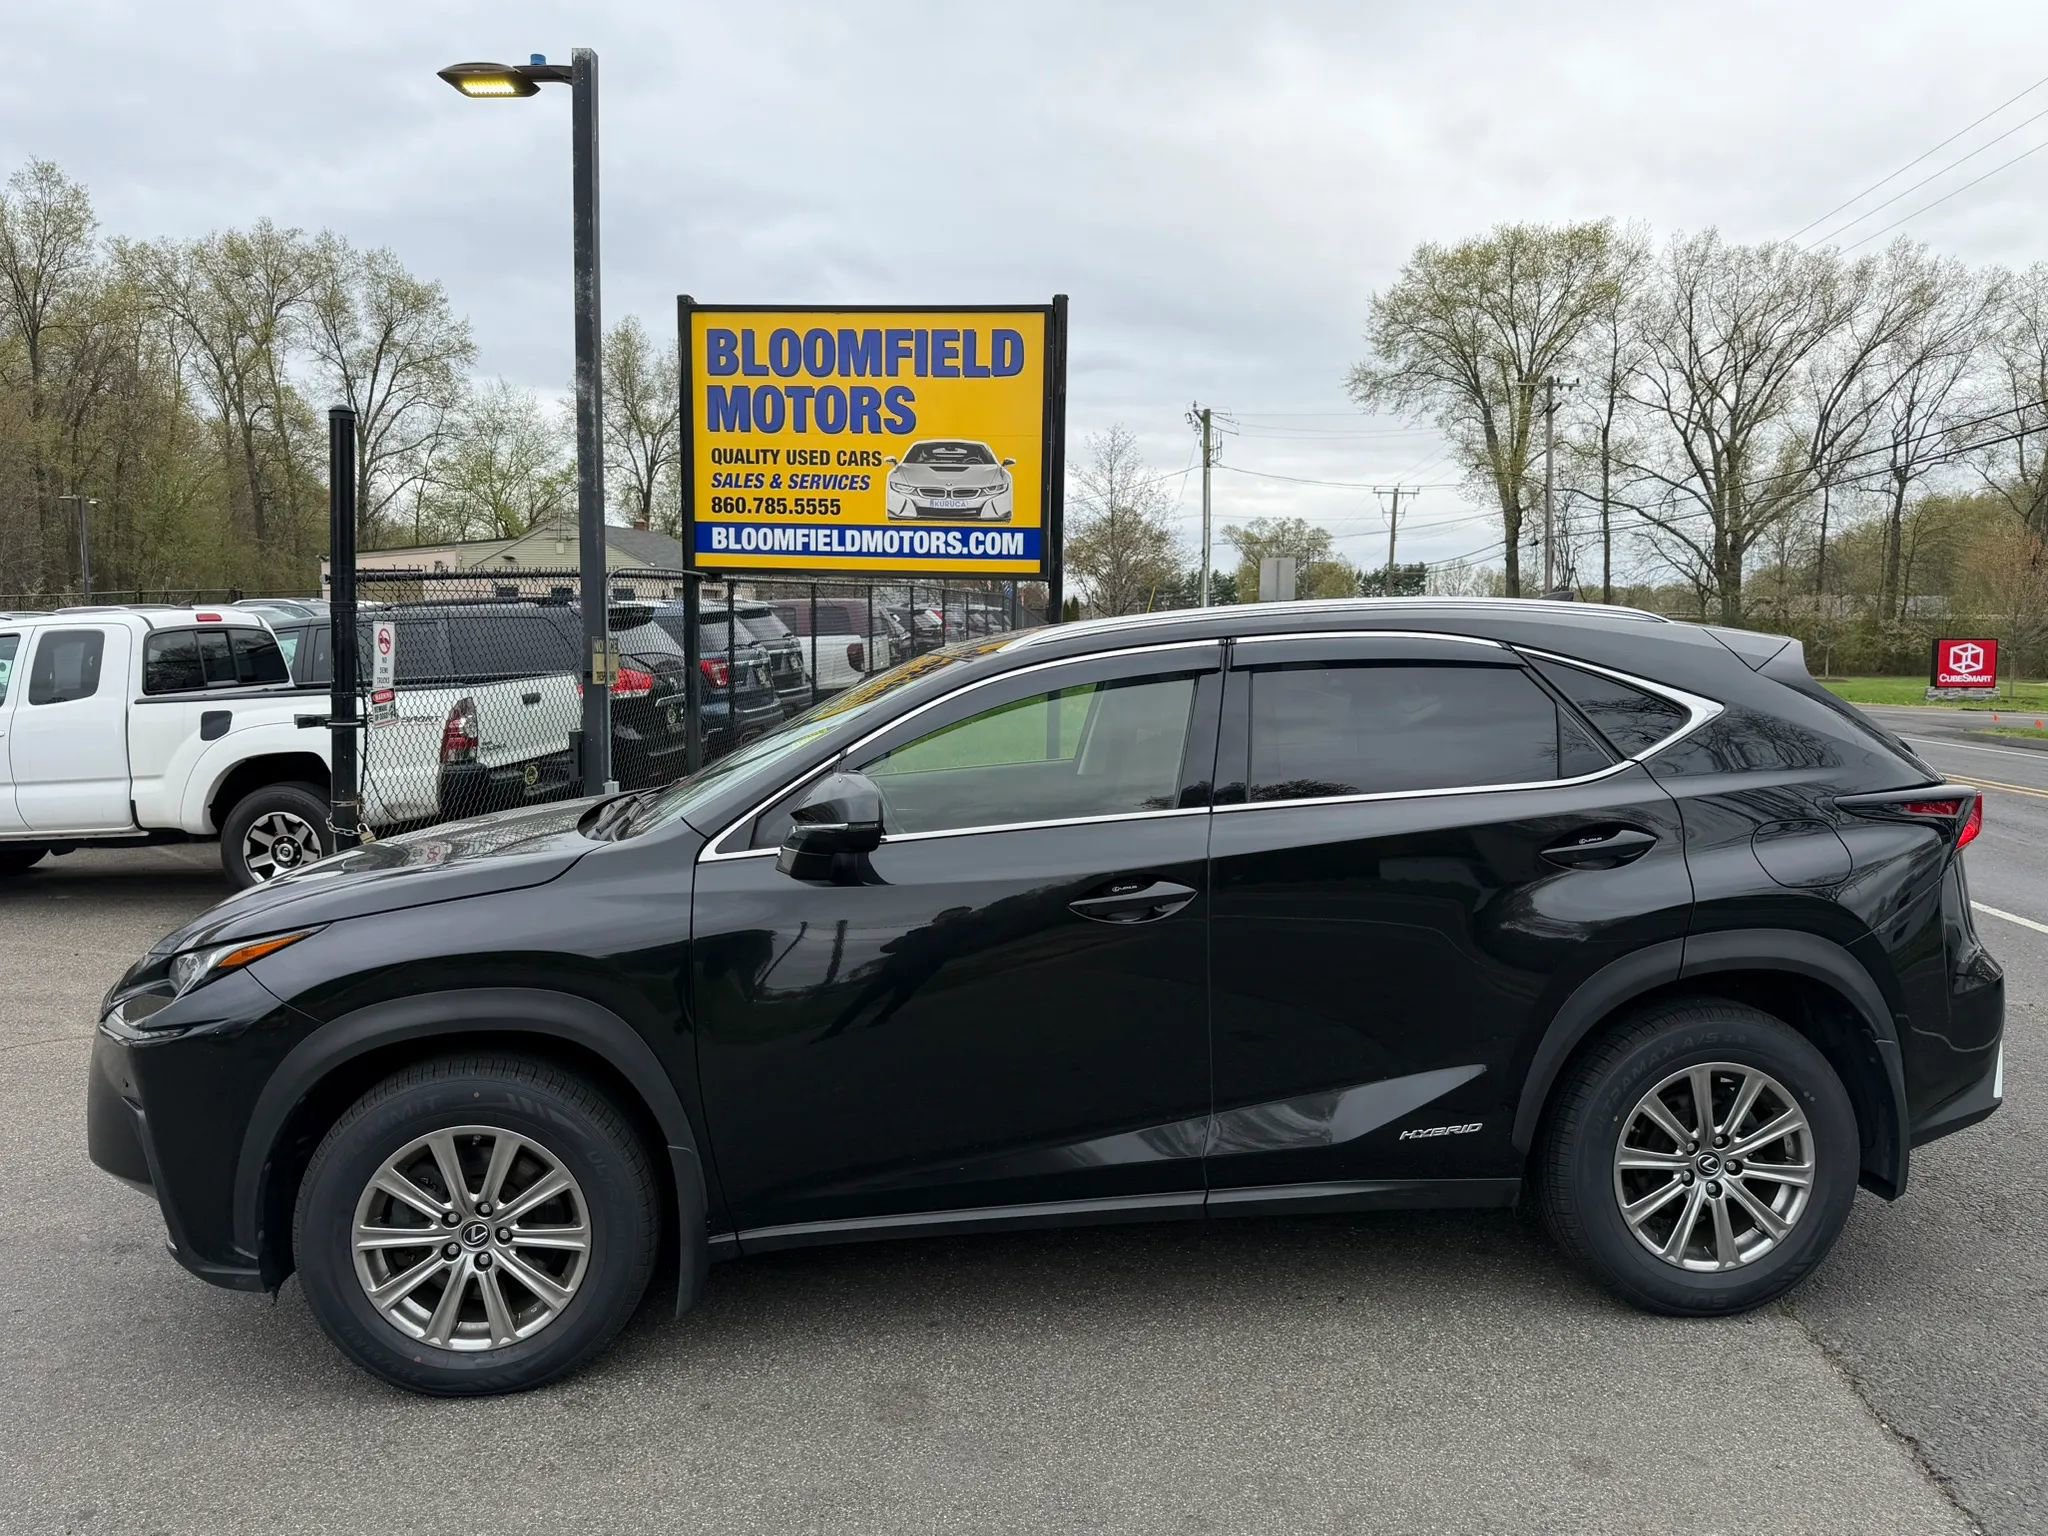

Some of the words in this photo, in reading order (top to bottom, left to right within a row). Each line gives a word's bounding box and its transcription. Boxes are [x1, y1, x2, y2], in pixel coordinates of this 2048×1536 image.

[706, 328, 1025, 378] BLOOMFIELD
[706, 385, 917, 435] MOTORS
[711, 447, 781, 466] QUALITY
[786, 449, 831, 466] USED
[836, 450, 882, 467] CARS
[711, 472, 765, 489] SALES
[769, 473, 783, 489] &
[787, 474, 871, 490] SERVICES
[711, 496, 841, 515] 860.785.5555
[711, 526, 1025, 556] BLOOMFIELDMOTORS.COM
[594, 639, 618, 652] NOCE
[1399, 1122, 1483, 1141] HYBRID
